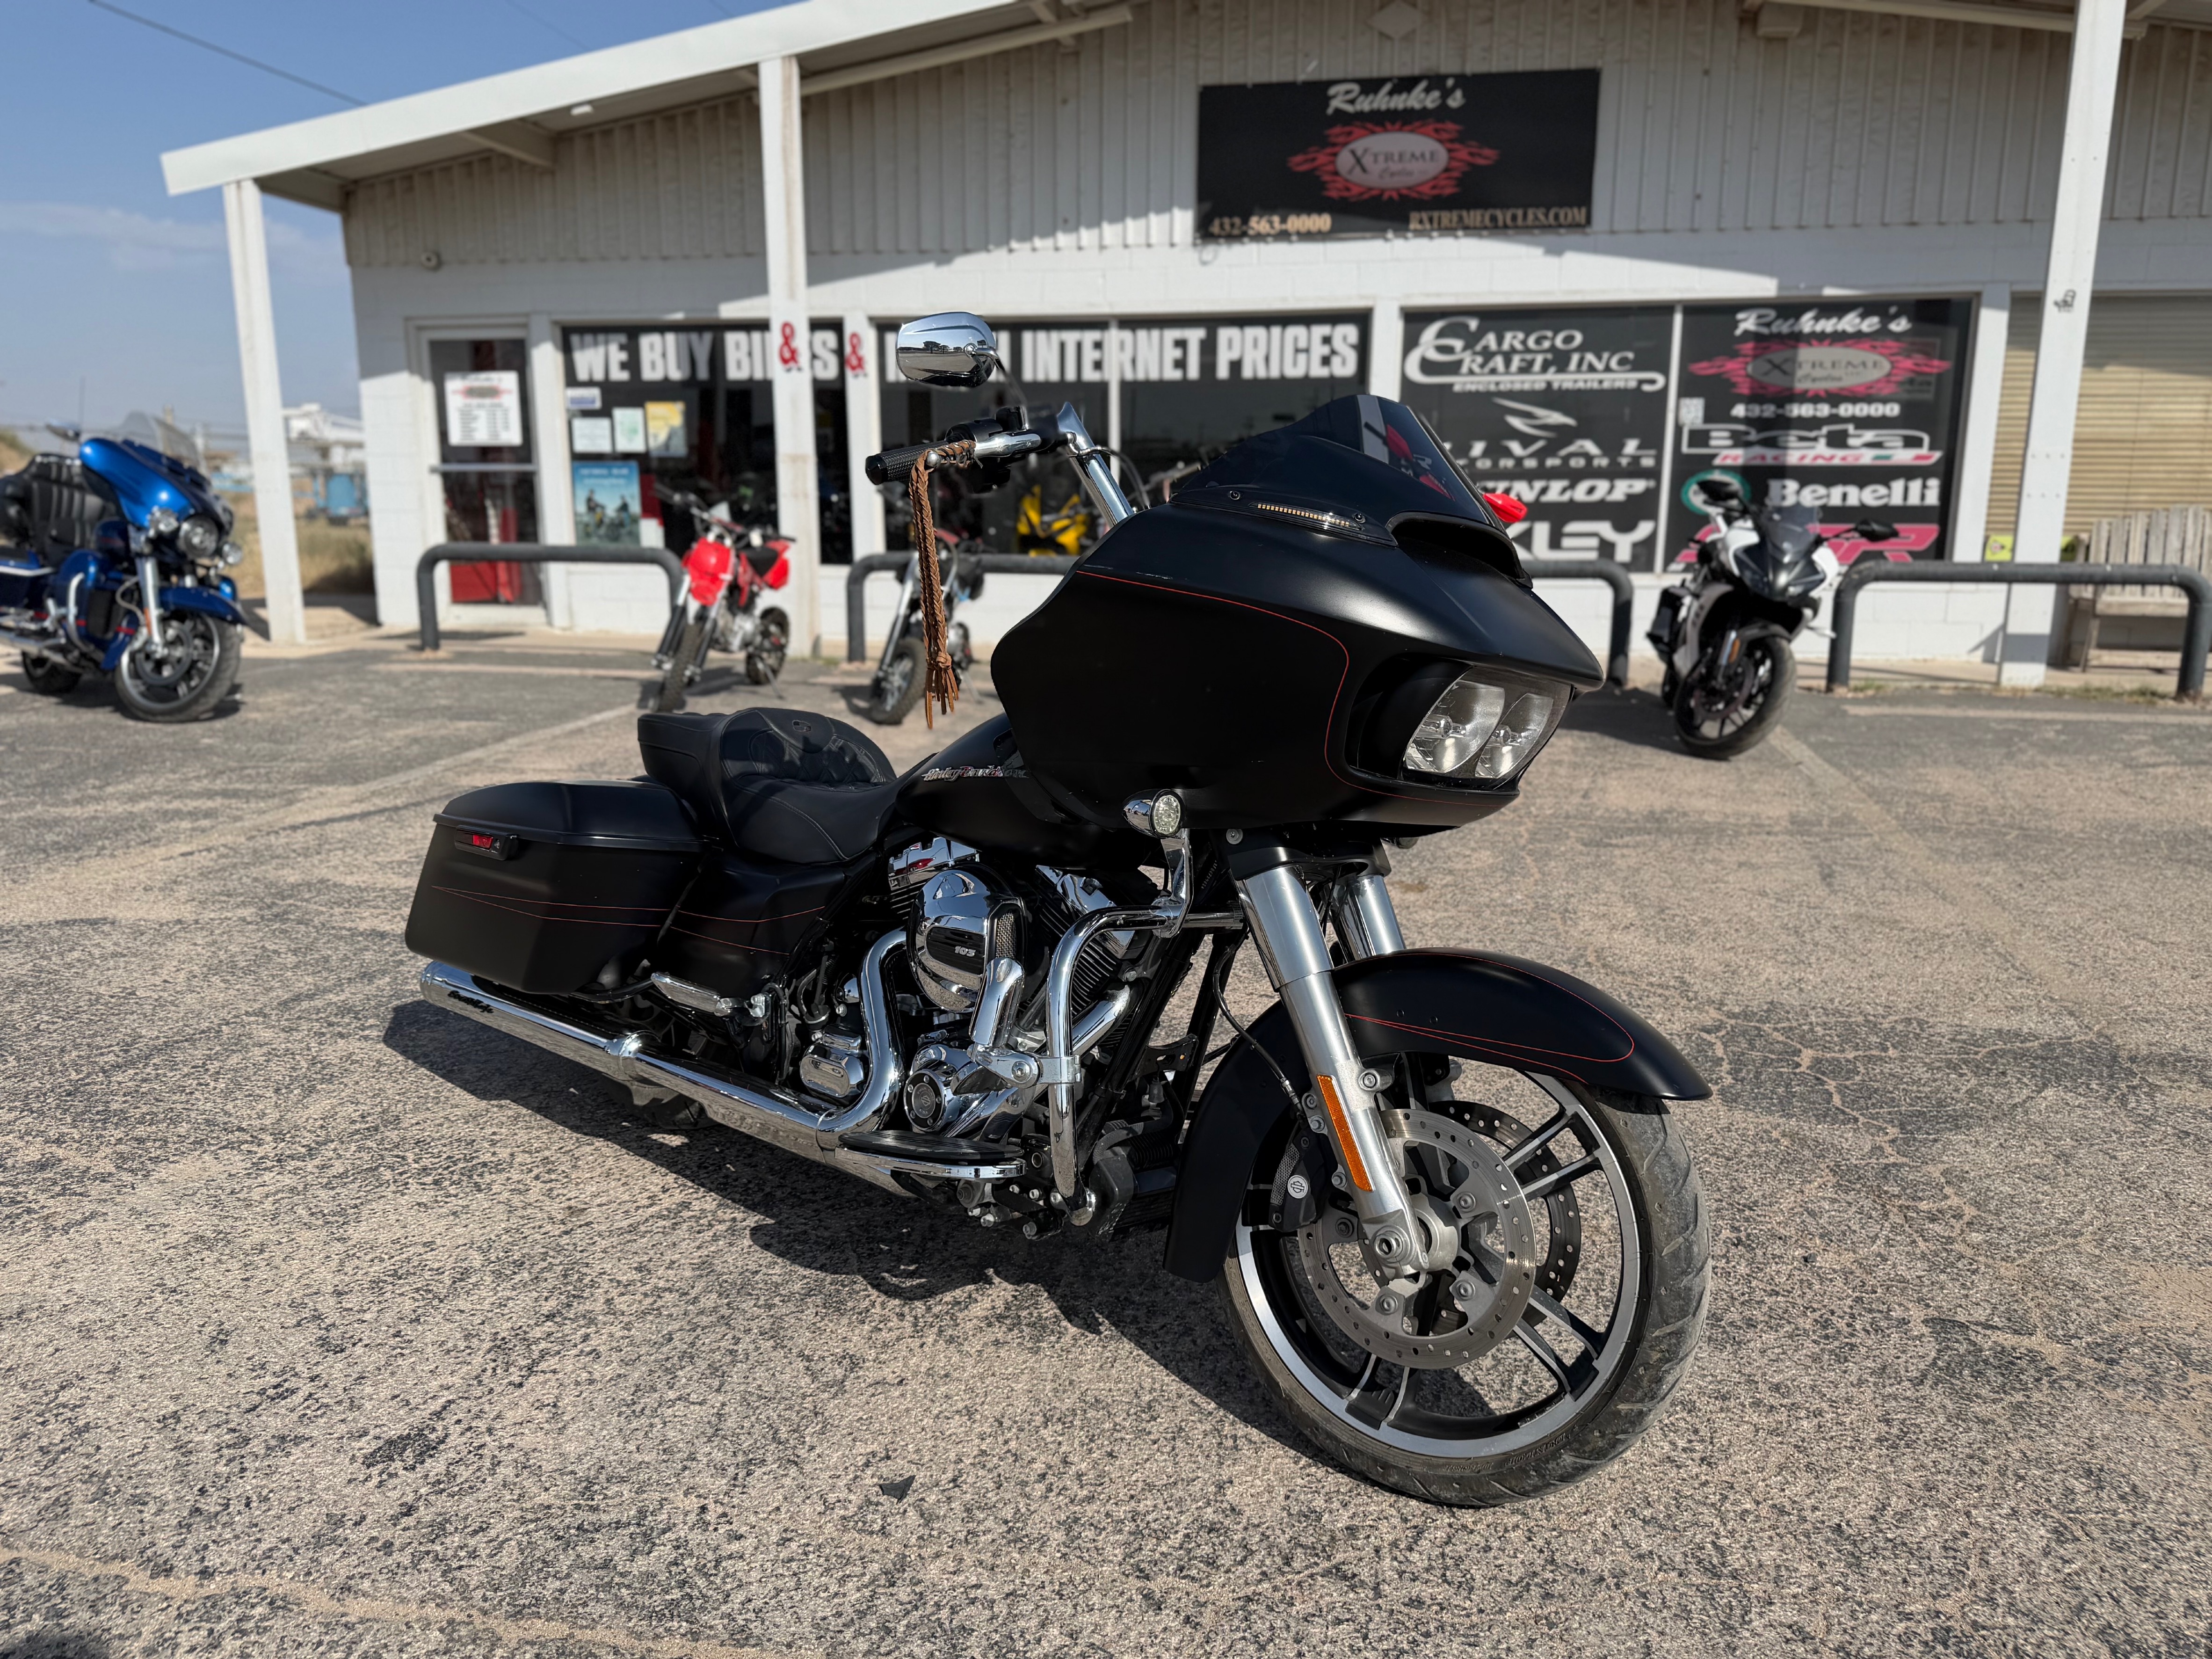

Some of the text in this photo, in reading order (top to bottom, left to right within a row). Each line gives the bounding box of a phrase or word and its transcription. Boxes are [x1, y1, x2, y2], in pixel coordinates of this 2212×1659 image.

[1326, 77, 1465, 115] Ruhnke's
[1208, 212, 1332, 236] 432-563-0000
[1409, 207, 1587, 232] RXTREMECYCLES.COM
[1734, 307, 1912, 336] Ruhnke's
[779, 321, 799, 365] &
[1419, 316, 1583, 361] CARGO
[569, 333, 631, 382] WE
[638, 331, 713, 382] BUY
[724, 330, 839, 380] BIS
[846, 333, 864, 371] &
[1023, 327, 1207, 382] INTERNET
[1217, 323, 1358, 381] PRICES
[1567, 352, 1634, 372] INC
[1452, 378, 1638, 392] ENCLOSED TRAILERS
[1731, 402, 1900, 418] 432-563-0000
[1443, 438, 1657, 458] IVAL
[1719, 452, 1865, 464] RACING
[1767, 478, 1940, 507] Benelli
[1506, 520, 1656, 562] KLEY
[955, 946, 976, 957] 103
